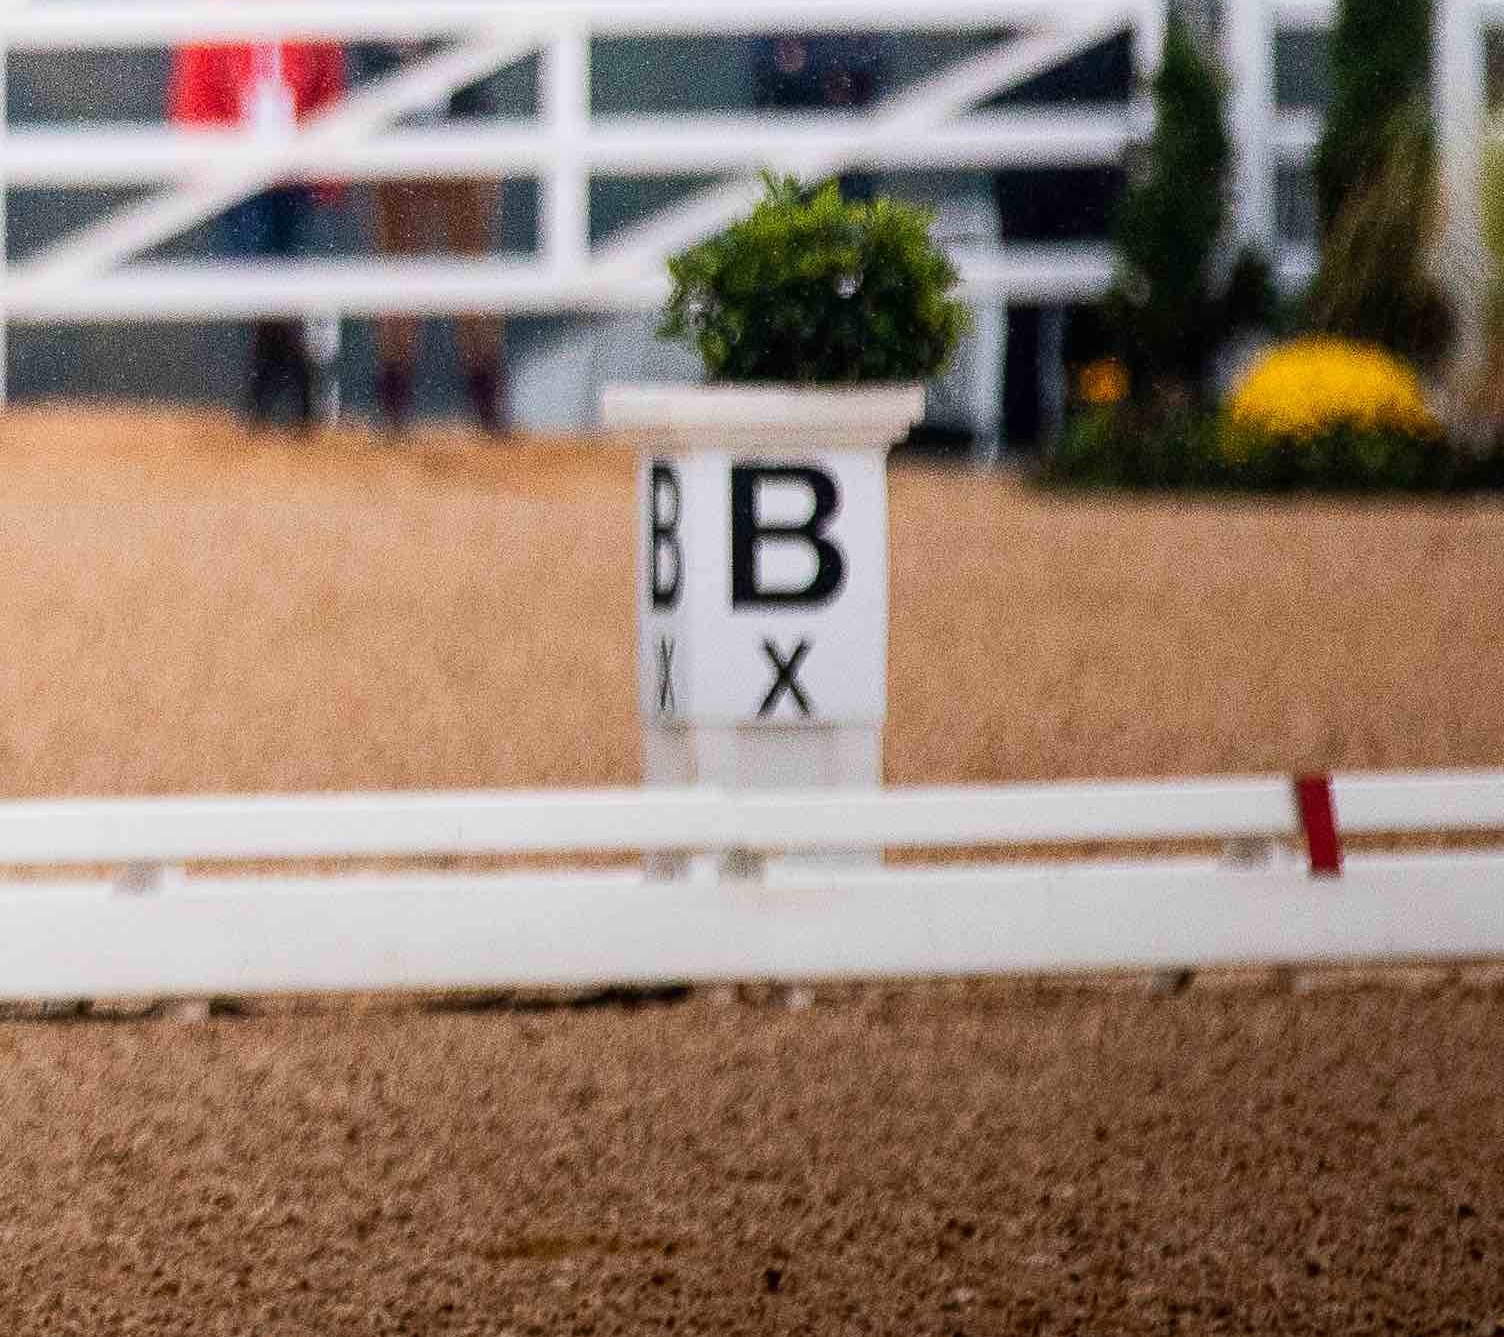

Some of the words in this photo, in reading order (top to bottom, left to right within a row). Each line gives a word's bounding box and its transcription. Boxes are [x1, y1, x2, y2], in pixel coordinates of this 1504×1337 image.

[653, 462, 682, 608] B
[731, 463, 845, 608] B
[756, 640, 812, 716] X
